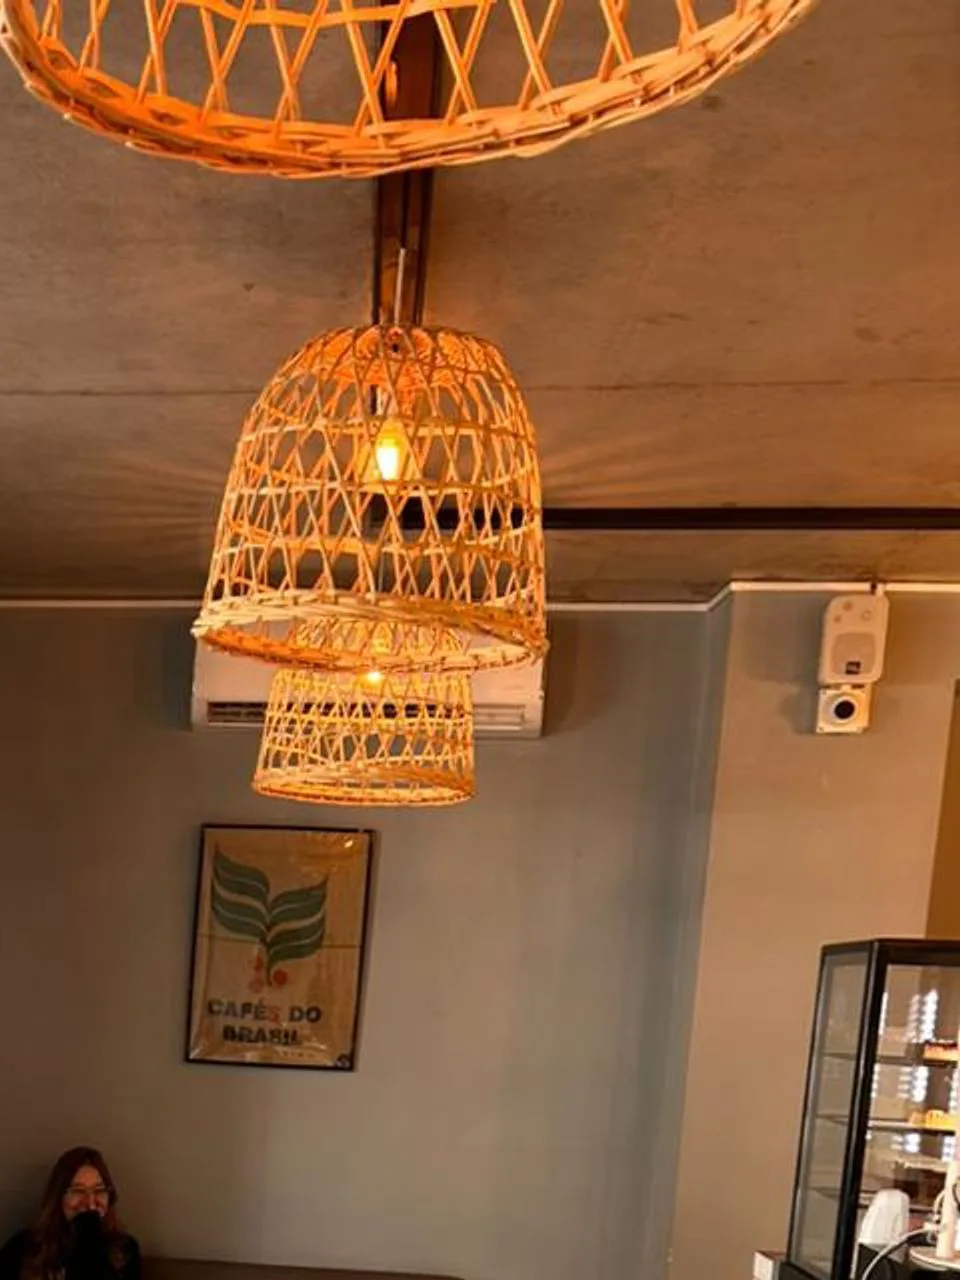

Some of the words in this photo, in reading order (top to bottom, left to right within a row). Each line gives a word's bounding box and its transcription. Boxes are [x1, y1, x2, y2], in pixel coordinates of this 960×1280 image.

[207, 998, 281, 1022] CAFÉS
[289, 1005, 322, 1023] DO
[223, 1024, 303, 1046] BRASIL
